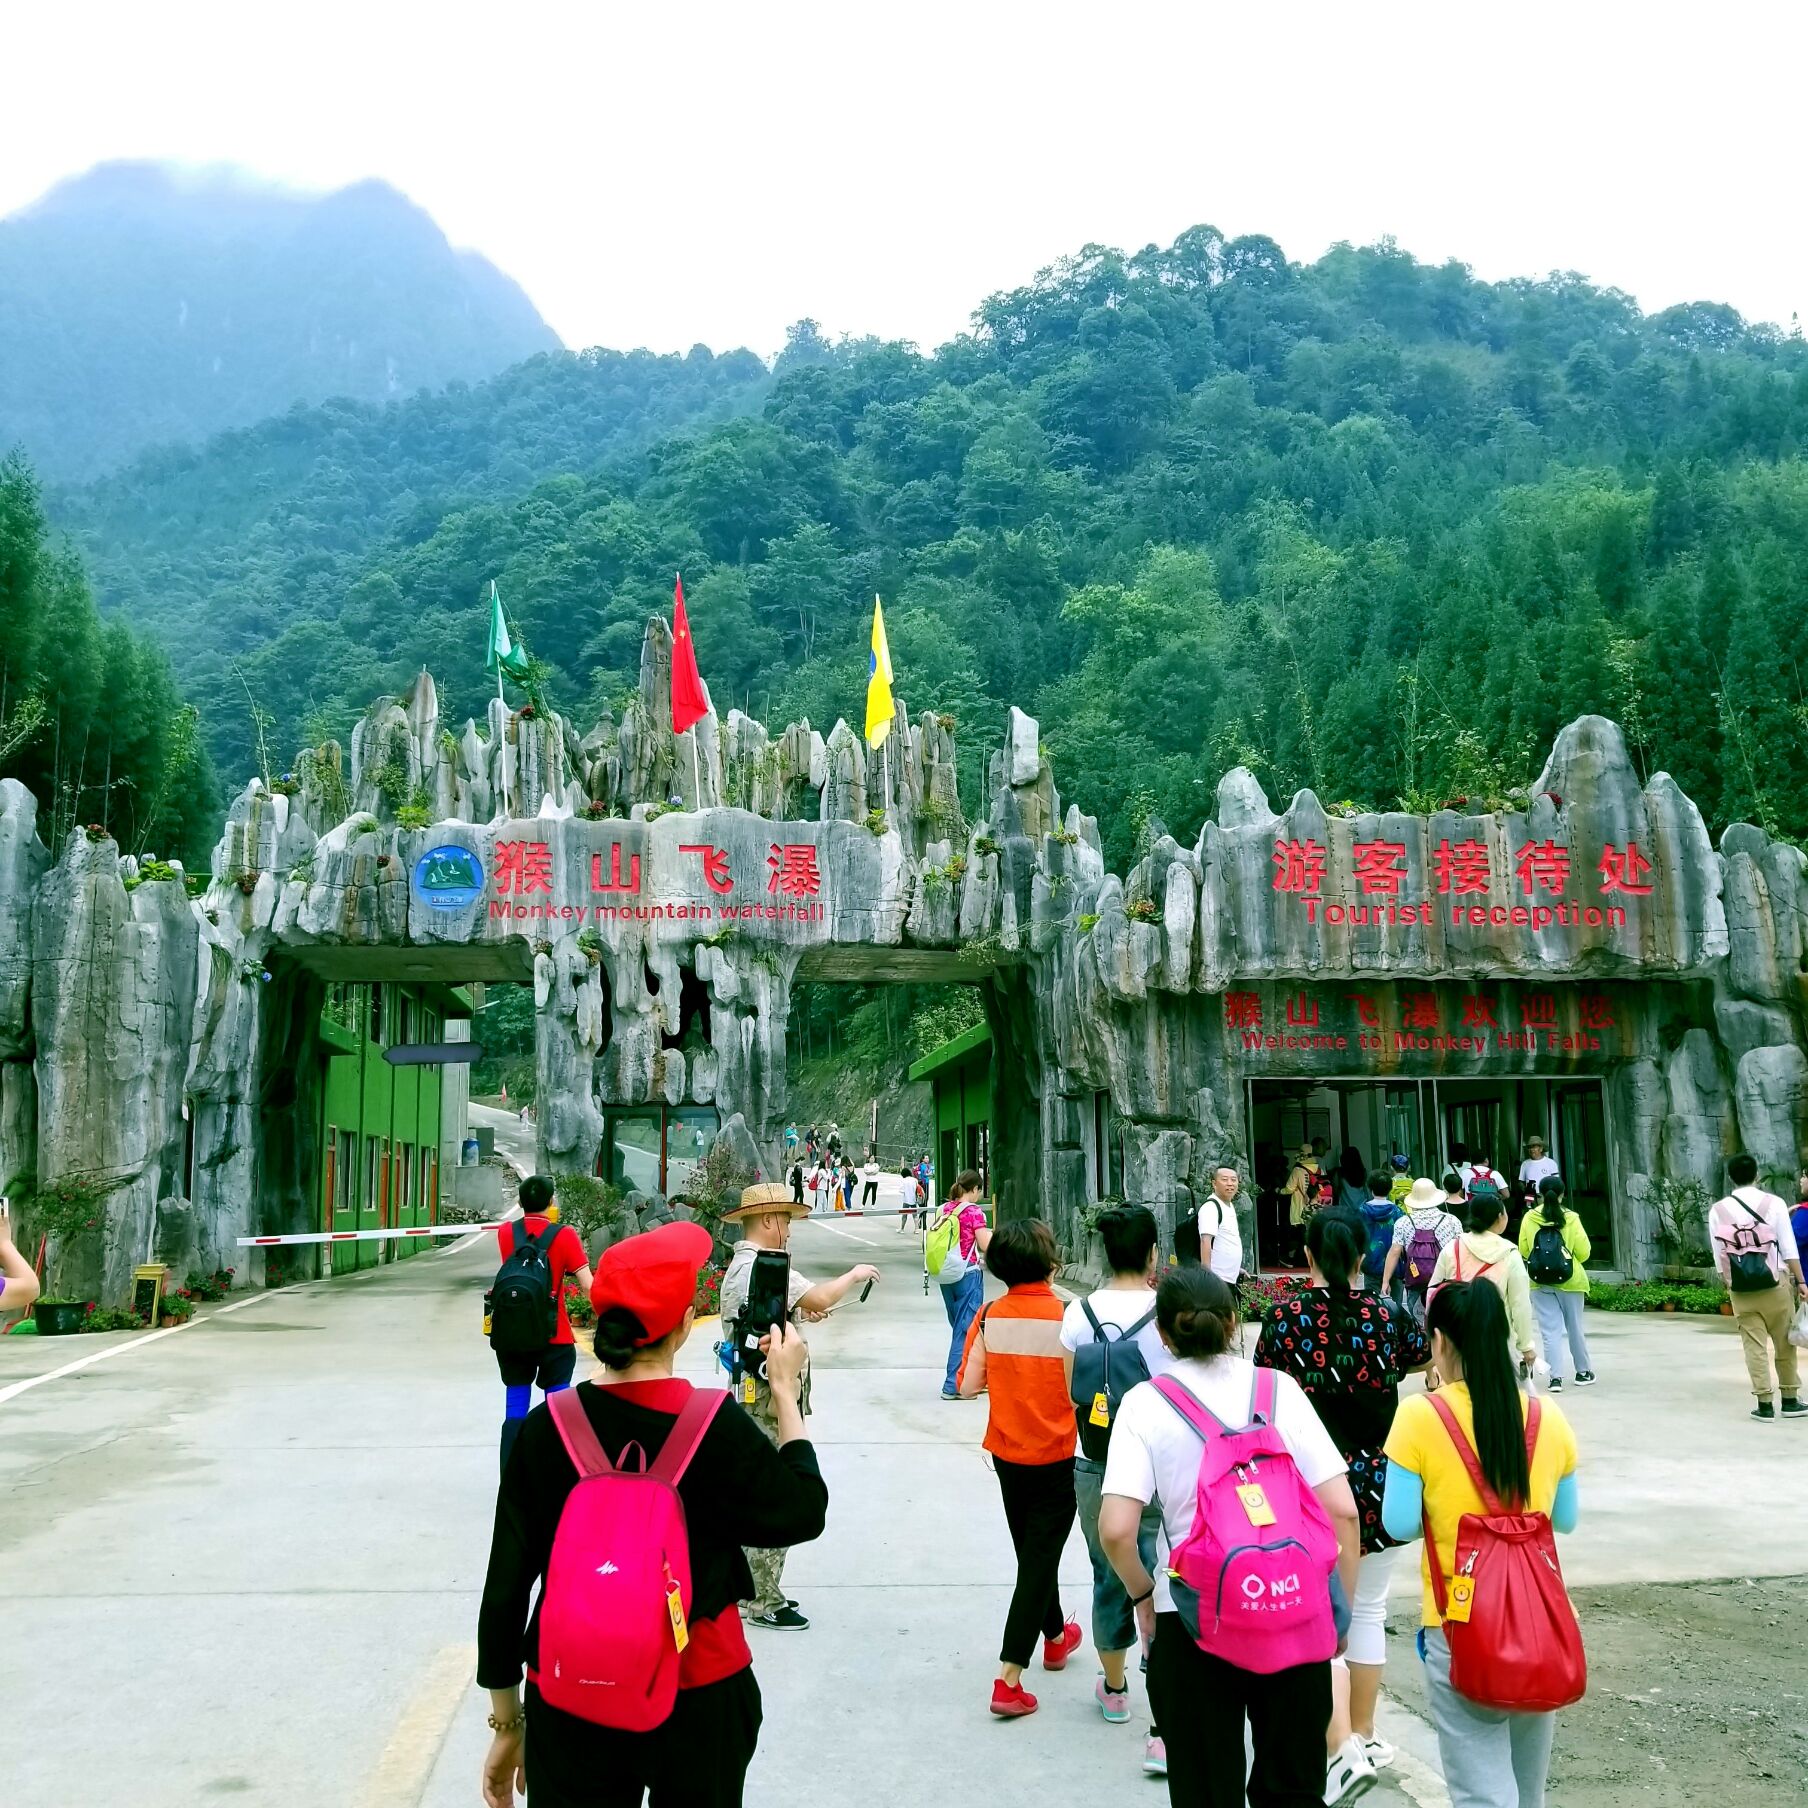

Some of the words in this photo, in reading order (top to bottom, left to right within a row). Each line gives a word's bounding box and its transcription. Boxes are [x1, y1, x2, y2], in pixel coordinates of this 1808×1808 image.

[492, 840, 821, 898] 猴山飞瀑
[1272, 838, 1654, 897] 游客接待处
[489, 900, 586, 923] Monkey
[595, 902, 711, 921] mountain
[719, 903, 824, 922] waterfall
[1299, 897, 1434, 926] Tourist
[1451, 899, 1626, 933] reception
[1225, 991, 1615, 1029] 猴山飞瀑欢迎您
[1241, 1031, 1347, 1050] Welcome
[1359, 1033, 1382, 1050] to
[1393, 1031, 1486, 1053] Monkey
[1497, 1031, 1535, 1050] Hill
[1547, 1031, 1601, 1051] Falls
